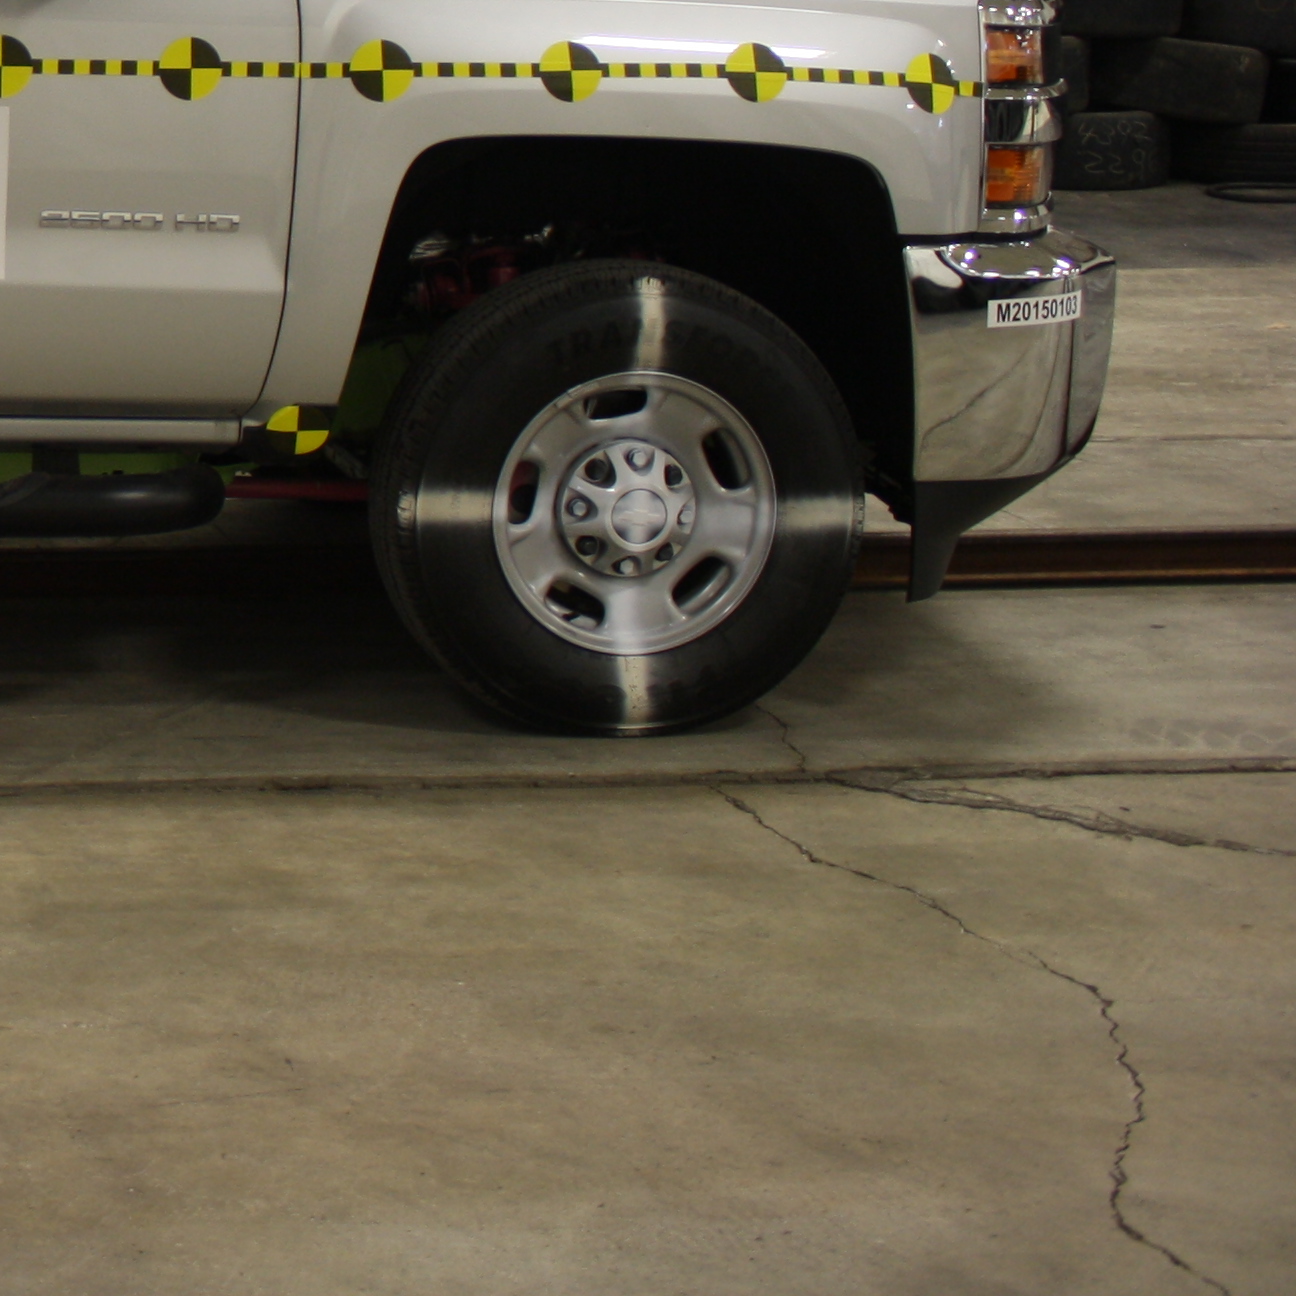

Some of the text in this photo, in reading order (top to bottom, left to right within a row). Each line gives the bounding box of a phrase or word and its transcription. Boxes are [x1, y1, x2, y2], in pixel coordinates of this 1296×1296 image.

[40, 210, 241, 232] 2500 HD
[996, 294, 1078, 323] M20150103
